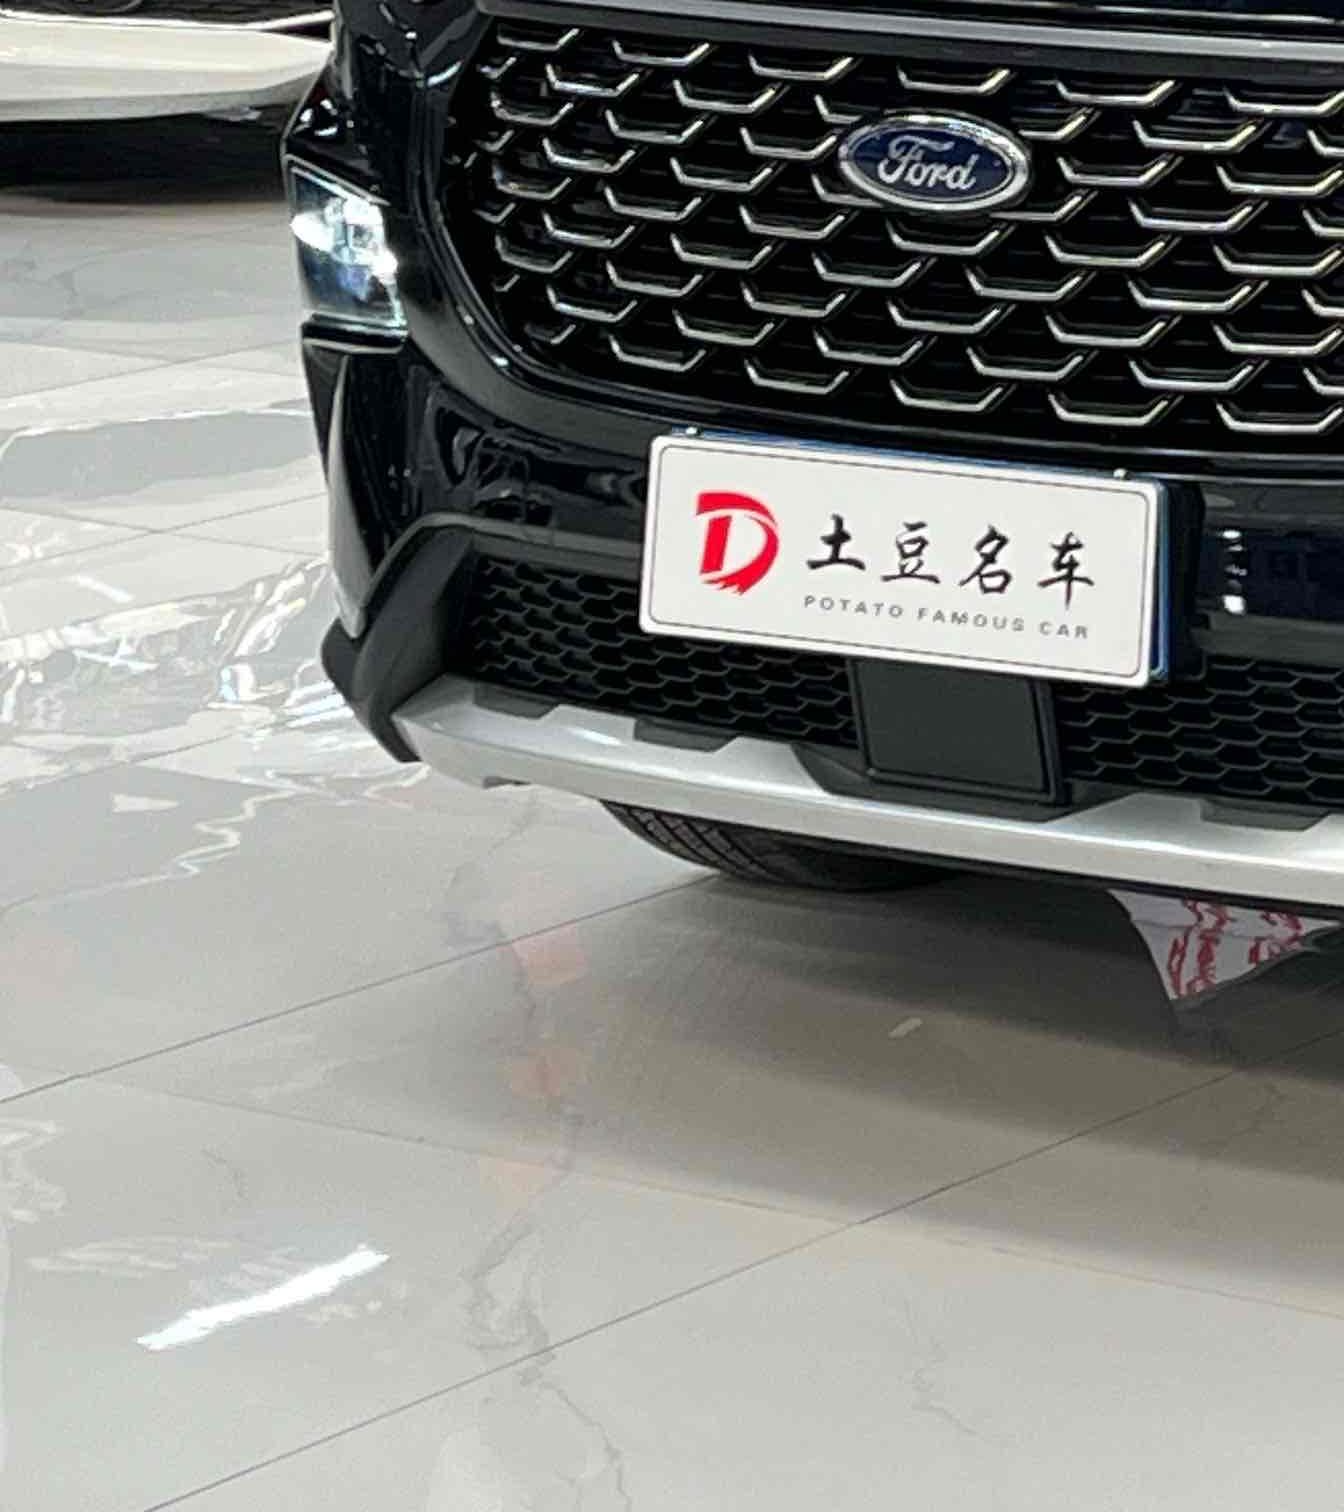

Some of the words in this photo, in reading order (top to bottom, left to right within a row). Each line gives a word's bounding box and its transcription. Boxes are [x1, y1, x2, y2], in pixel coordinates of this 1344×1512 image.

[877, 135, 979, 190] Ford
[806, 513, 1095, 610] 土豆名车
[804, 594, 904, 618] POTATO
[917, 607, 1025, 632] FAMOUS
[1038, 620, 1089, 640] CAR
